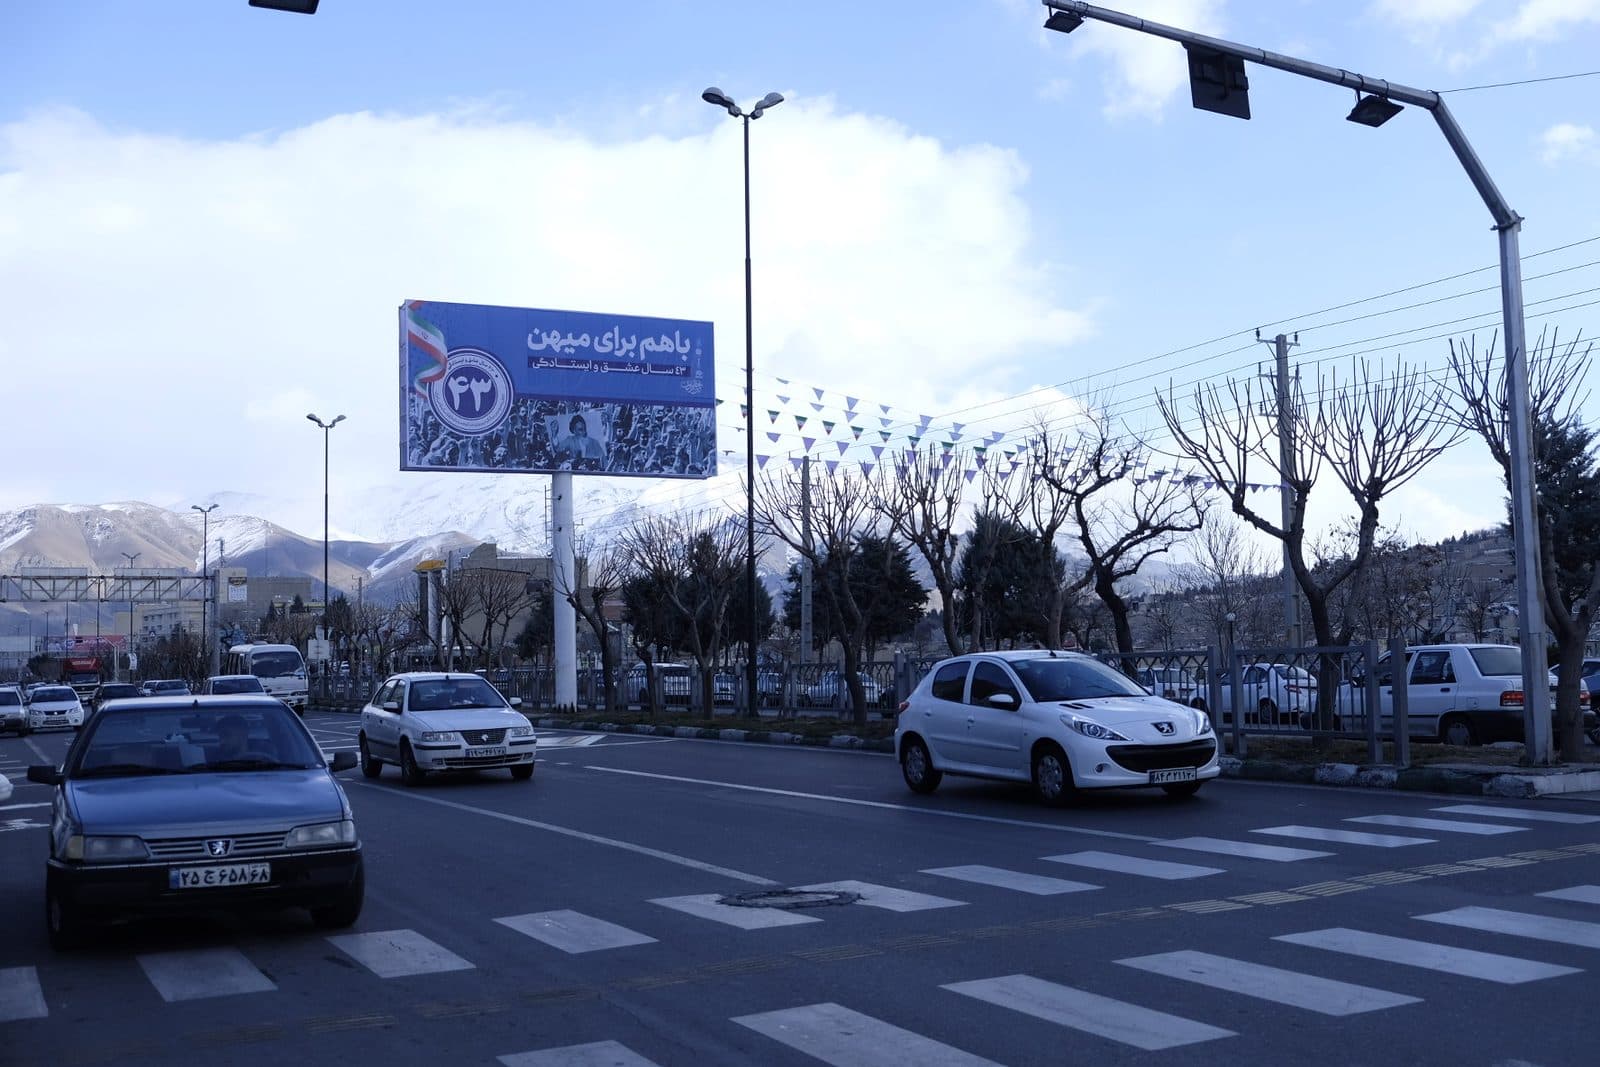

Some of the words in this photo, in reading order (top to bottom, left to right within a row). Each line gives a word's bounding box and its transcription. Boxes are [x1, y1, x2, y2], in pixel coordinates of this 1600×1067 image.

[527, 327, 591, 354] میهن
[594, 325, 637, 358] برای
[532, 357, 592, 372] ایستادگی
[594, 364, 599, 372] و
[600, 362, 640, 373] عشق
[642, 362, 674, 375] سال
